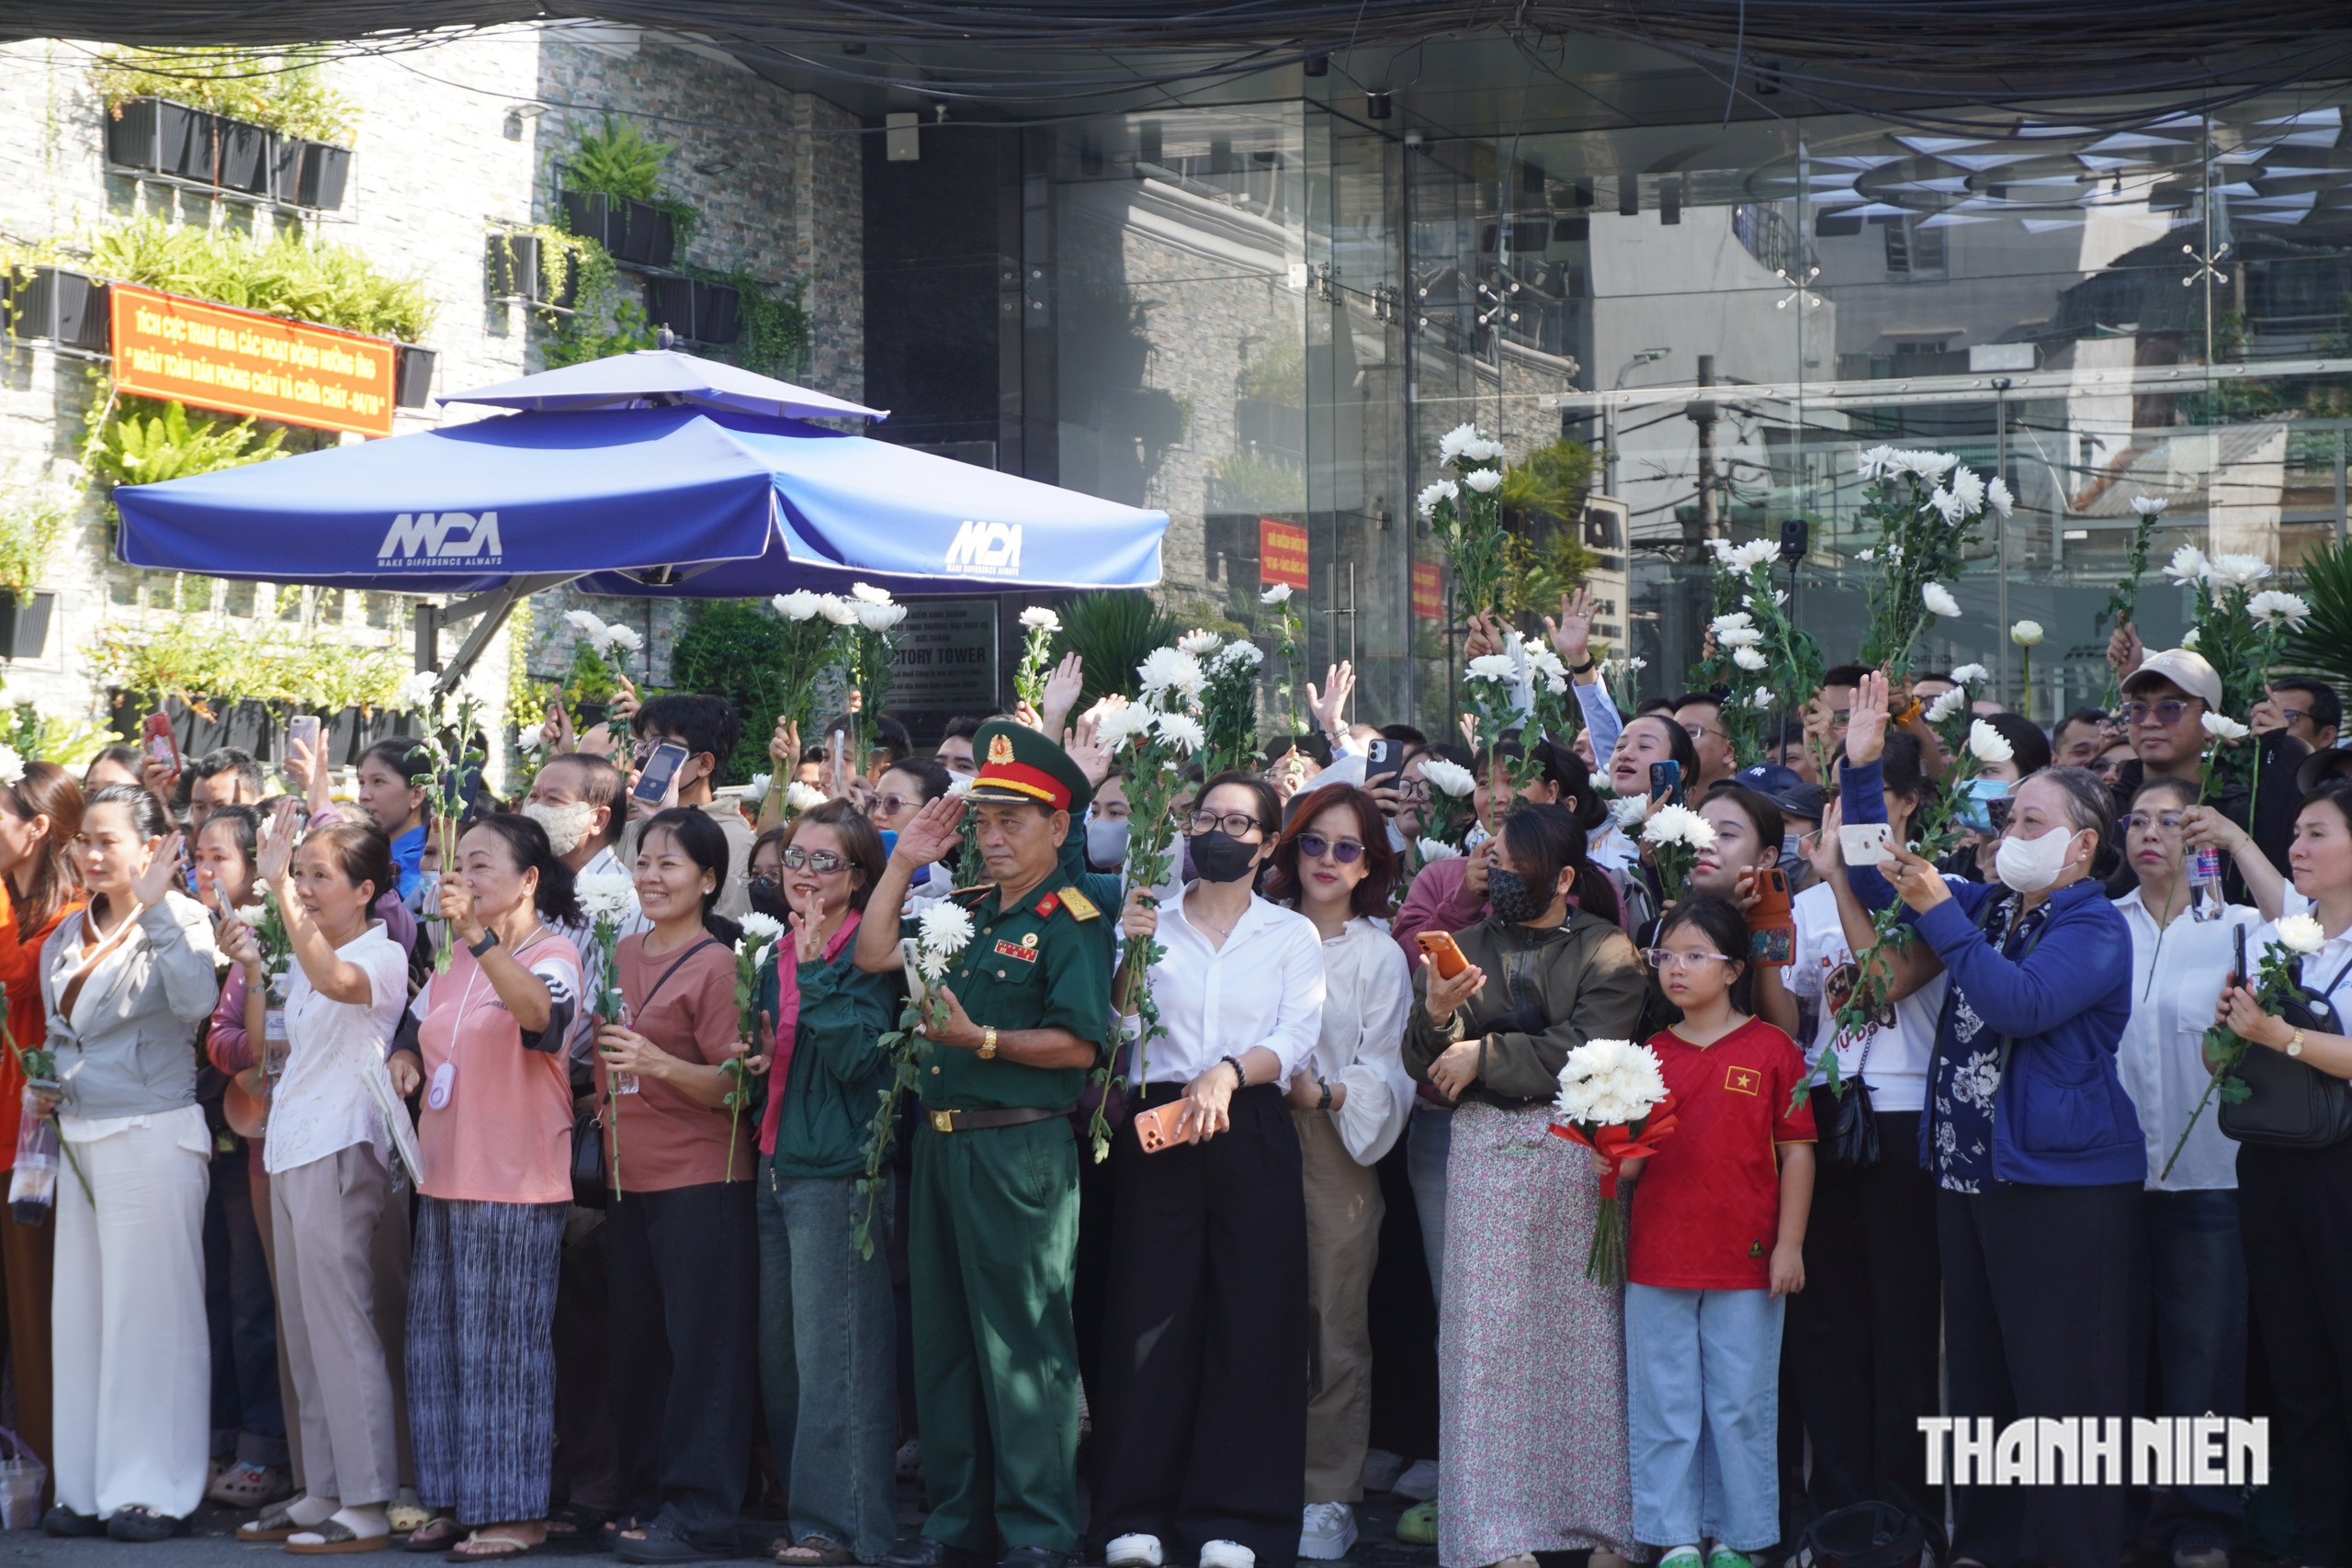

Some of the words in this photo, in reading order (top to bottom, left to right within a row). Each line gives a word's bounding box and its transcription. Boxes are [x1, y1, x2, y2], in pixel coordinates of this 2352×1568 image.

[187, 321, 217, 348] THAM
[218, 327, 237, 352] GIA
[238, 328, 261, 357] CÁC
[378, 558, 403, 567] MAKE
[406, 558, 461, 567] DIFFERENCE
[465, 557, 503, 566] ALWAYS
[893, 649, 933, 664] CTORY
[937, 647, 986, 664] TOWER
